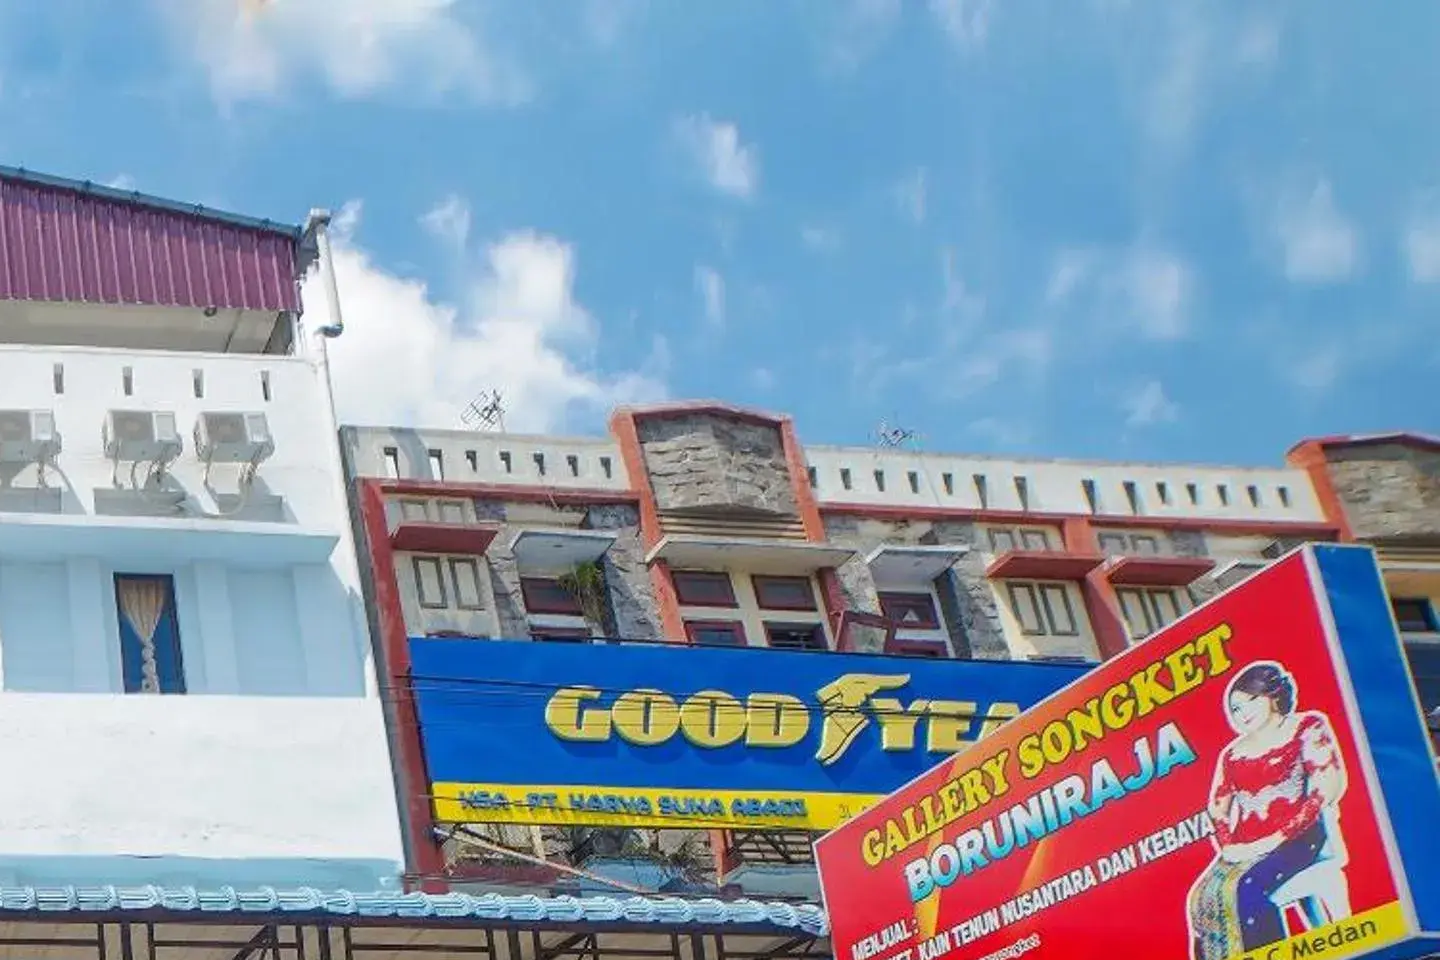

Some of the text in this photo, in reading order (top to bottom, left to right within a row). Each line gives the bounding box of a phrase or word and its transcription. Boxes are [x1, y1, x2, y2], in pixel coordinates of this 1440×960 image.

[861, 623, 1233, 867] GALLERY SONGKET
[904, 721, 1198, 902] BORUNIRAJA
[951, 908, 999, 947] TENUN
[1000, 868, 1097, 926] NUSANTARA
[1098, 848, 1137, 882] DAN
[1138, 811, 1215, 865] KEBAYA
[1291, 918, 1377, 960] Medan
